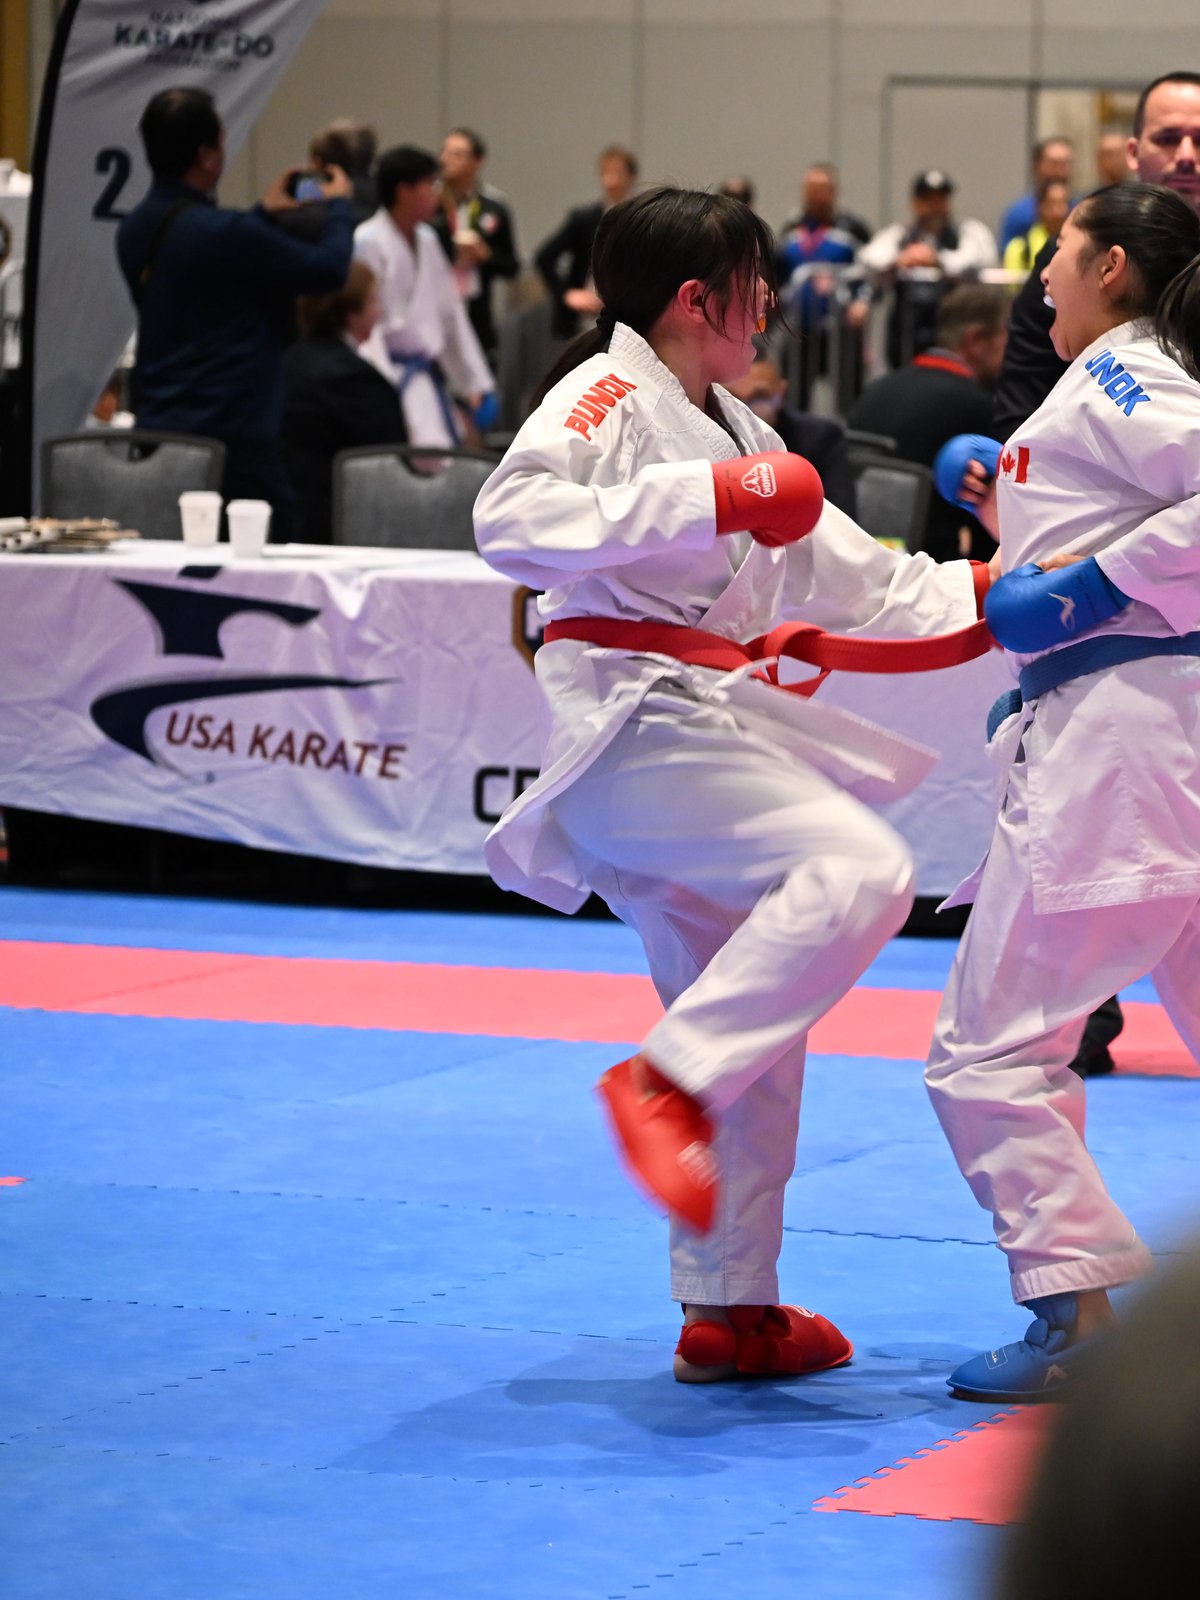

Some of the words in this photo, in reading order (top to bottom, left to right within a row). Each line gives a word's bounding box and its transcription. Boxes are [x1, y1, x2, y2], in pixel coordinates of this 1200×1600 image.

[564, 373, 638, 441] PUNOK
[166, 712, 235, 754] USA
[249, 724, 406, 779] KARATE
